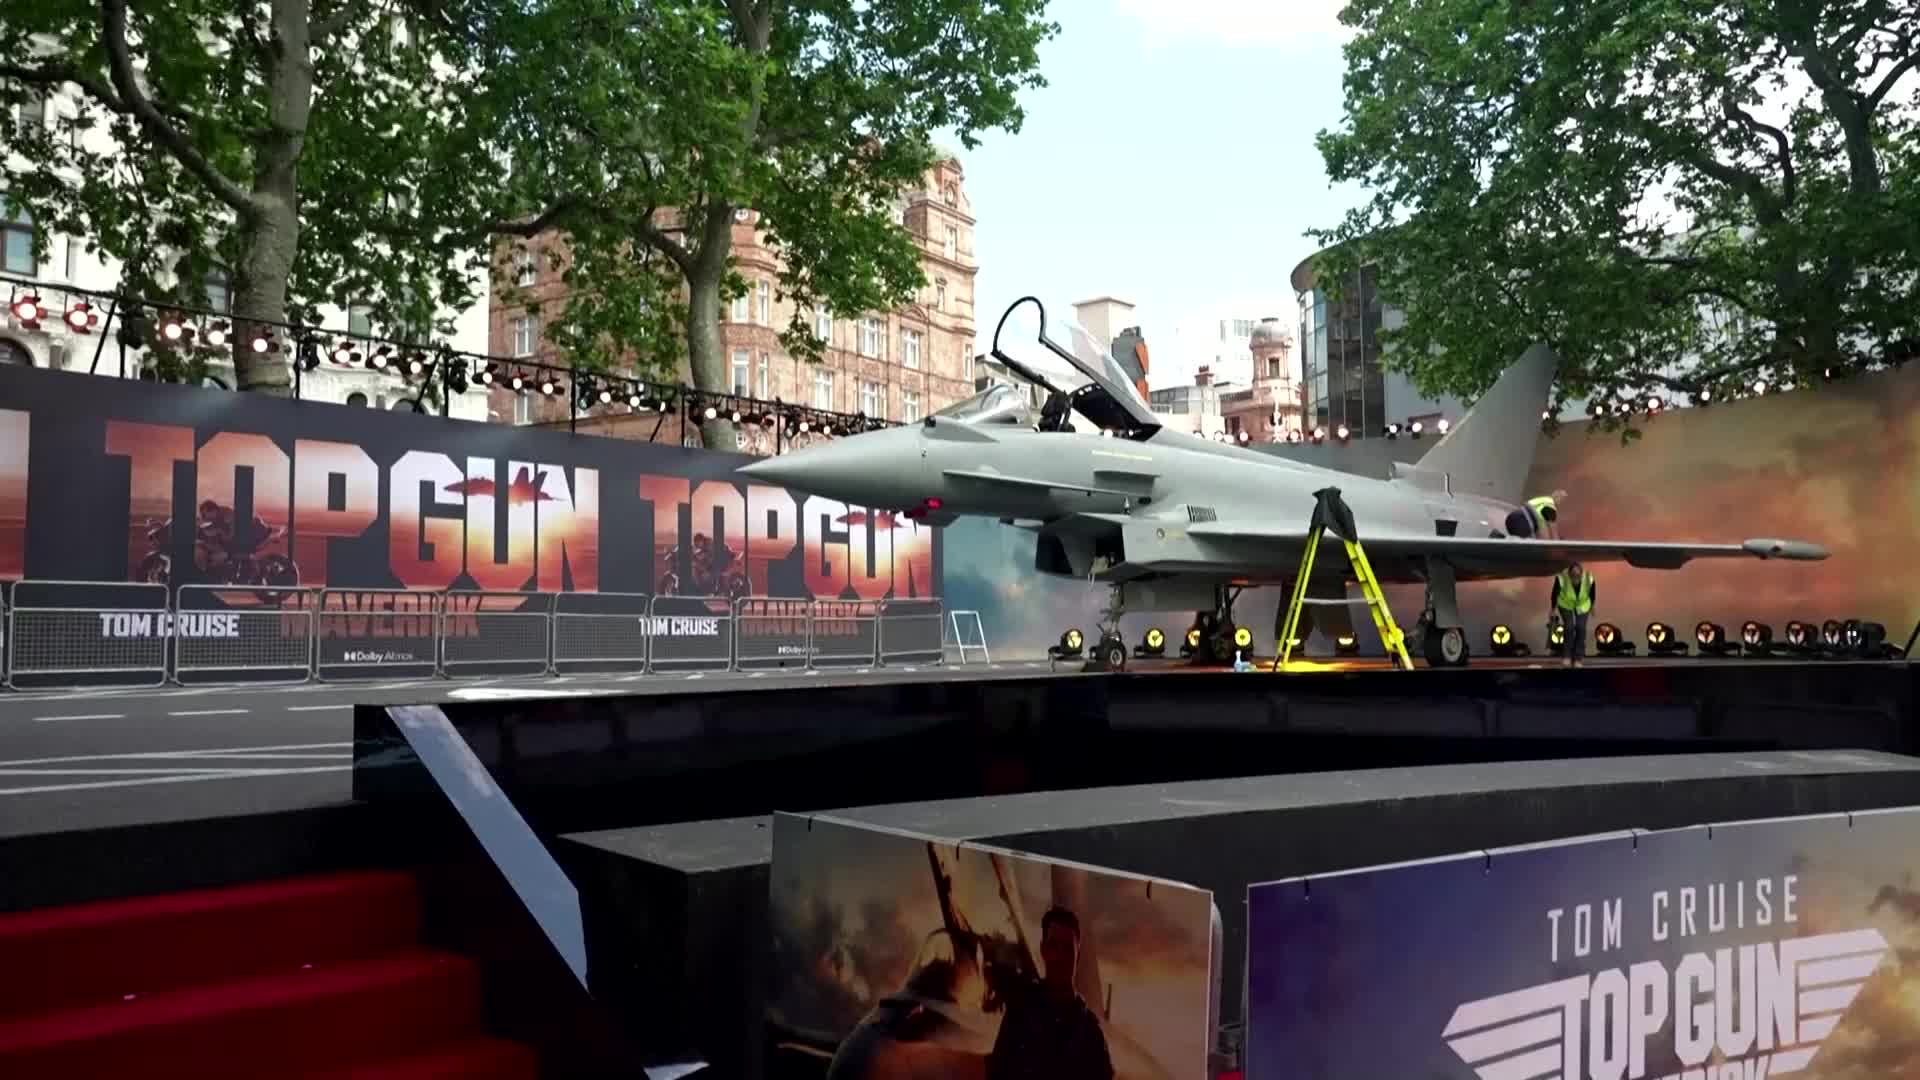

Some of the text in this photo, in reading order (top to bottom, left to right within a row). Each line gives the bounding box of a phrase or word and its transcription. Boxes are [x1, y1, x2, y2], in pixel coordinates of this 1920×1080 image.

[105, 420, 379, 588] TOP
[390, 449, 599, 593] GUN
[639, 473, 933, 601] TOP GUN
[100, 613, 241, 637] TOM CRUISE
[357, 651, 384, 663] Dolby
[671, 617, 719, 636] CRUISE
[1546, 874, 1798, 962] TOM CRUISE
[1561, 938, 1798, 1080] TOP GUN
